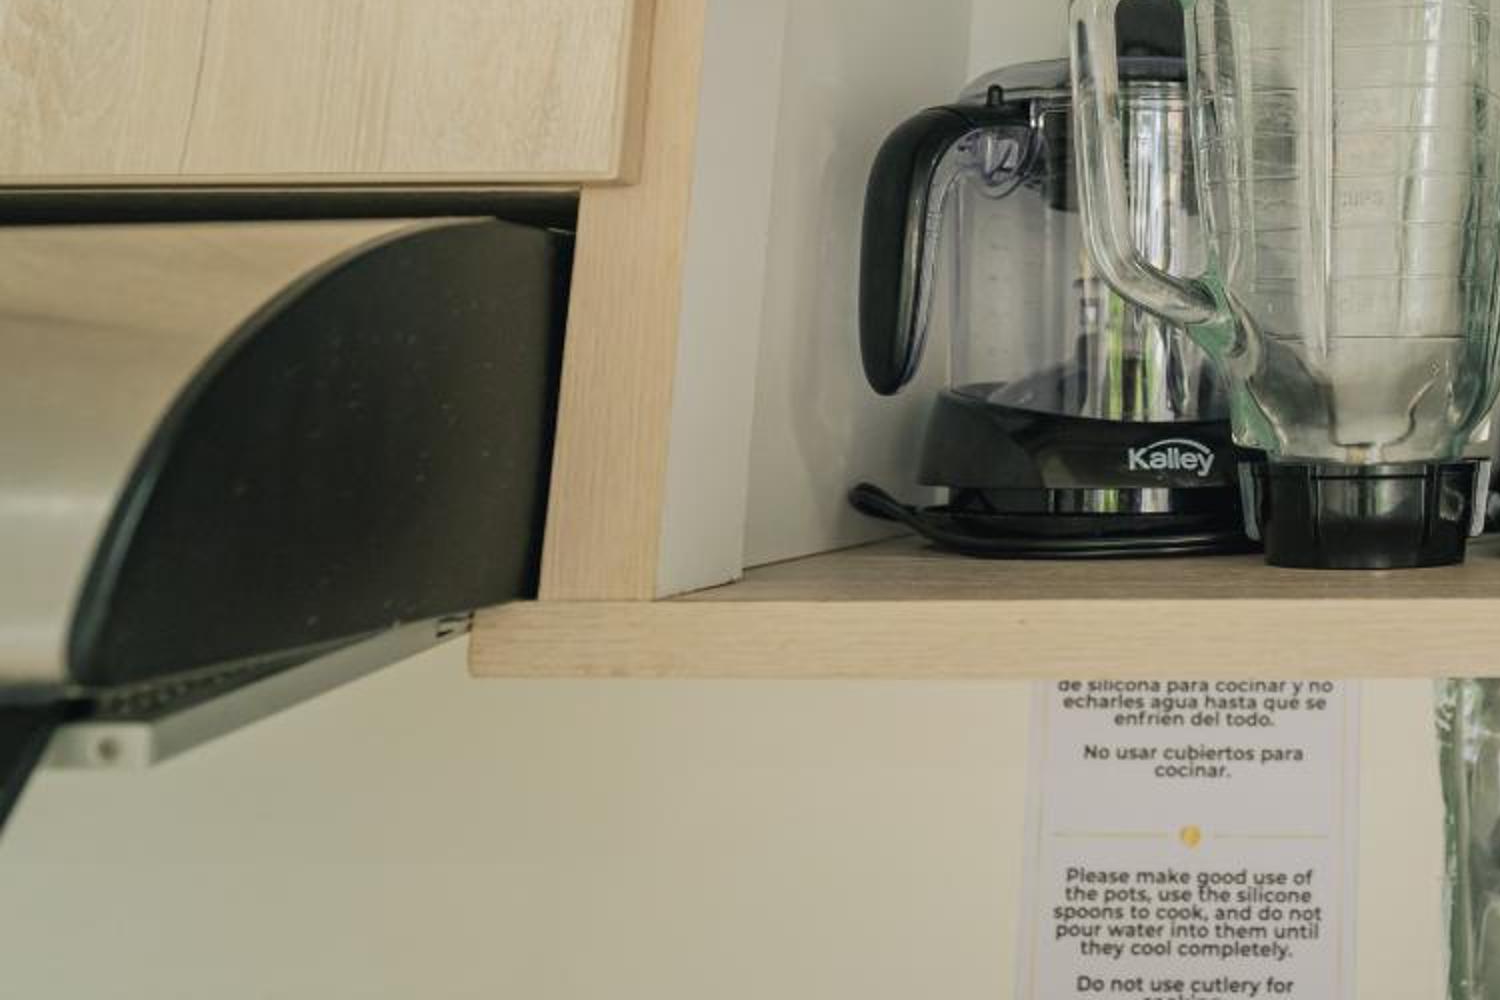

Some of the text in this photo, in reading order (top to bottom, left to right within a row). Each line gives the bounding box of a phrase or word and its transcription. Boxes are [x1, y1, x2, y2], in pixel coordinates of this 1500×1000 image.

[1128, 447, 1214, 477] Kalley
[1167, 680, 1209, 696] para
[1215, 680, 1286, 693] cocinar
[1289, 681, 1303, 697] y
[1309, 681, 1334, 693] no
[1063, 694, 1145, 709] echarles
[1151, 697, 1198, 712] agua
[1205, 695, 1257, 710] hasta
[1305, 698, 1327, 711] se
[1190, 711, 1219, 727] del
[1226, 712, 1275, 727] todo.
[1084, 744, 1304, 765] No usar cubiertos para
[1154, 762, 1232, 777] cocinar.
[1066, 867, 1313, 889] Please make good use of
[1065, 886, 1313, 904] the pots, use the silicone
[1054, 904, 1323, 922] spoons to cook, and do not
[1055, 922, 1320, 940] pour water into them until
[1081, 940, 1293, 961] they cool completely.
[1077, 975, 1295, 997] Do not use cutlery for
